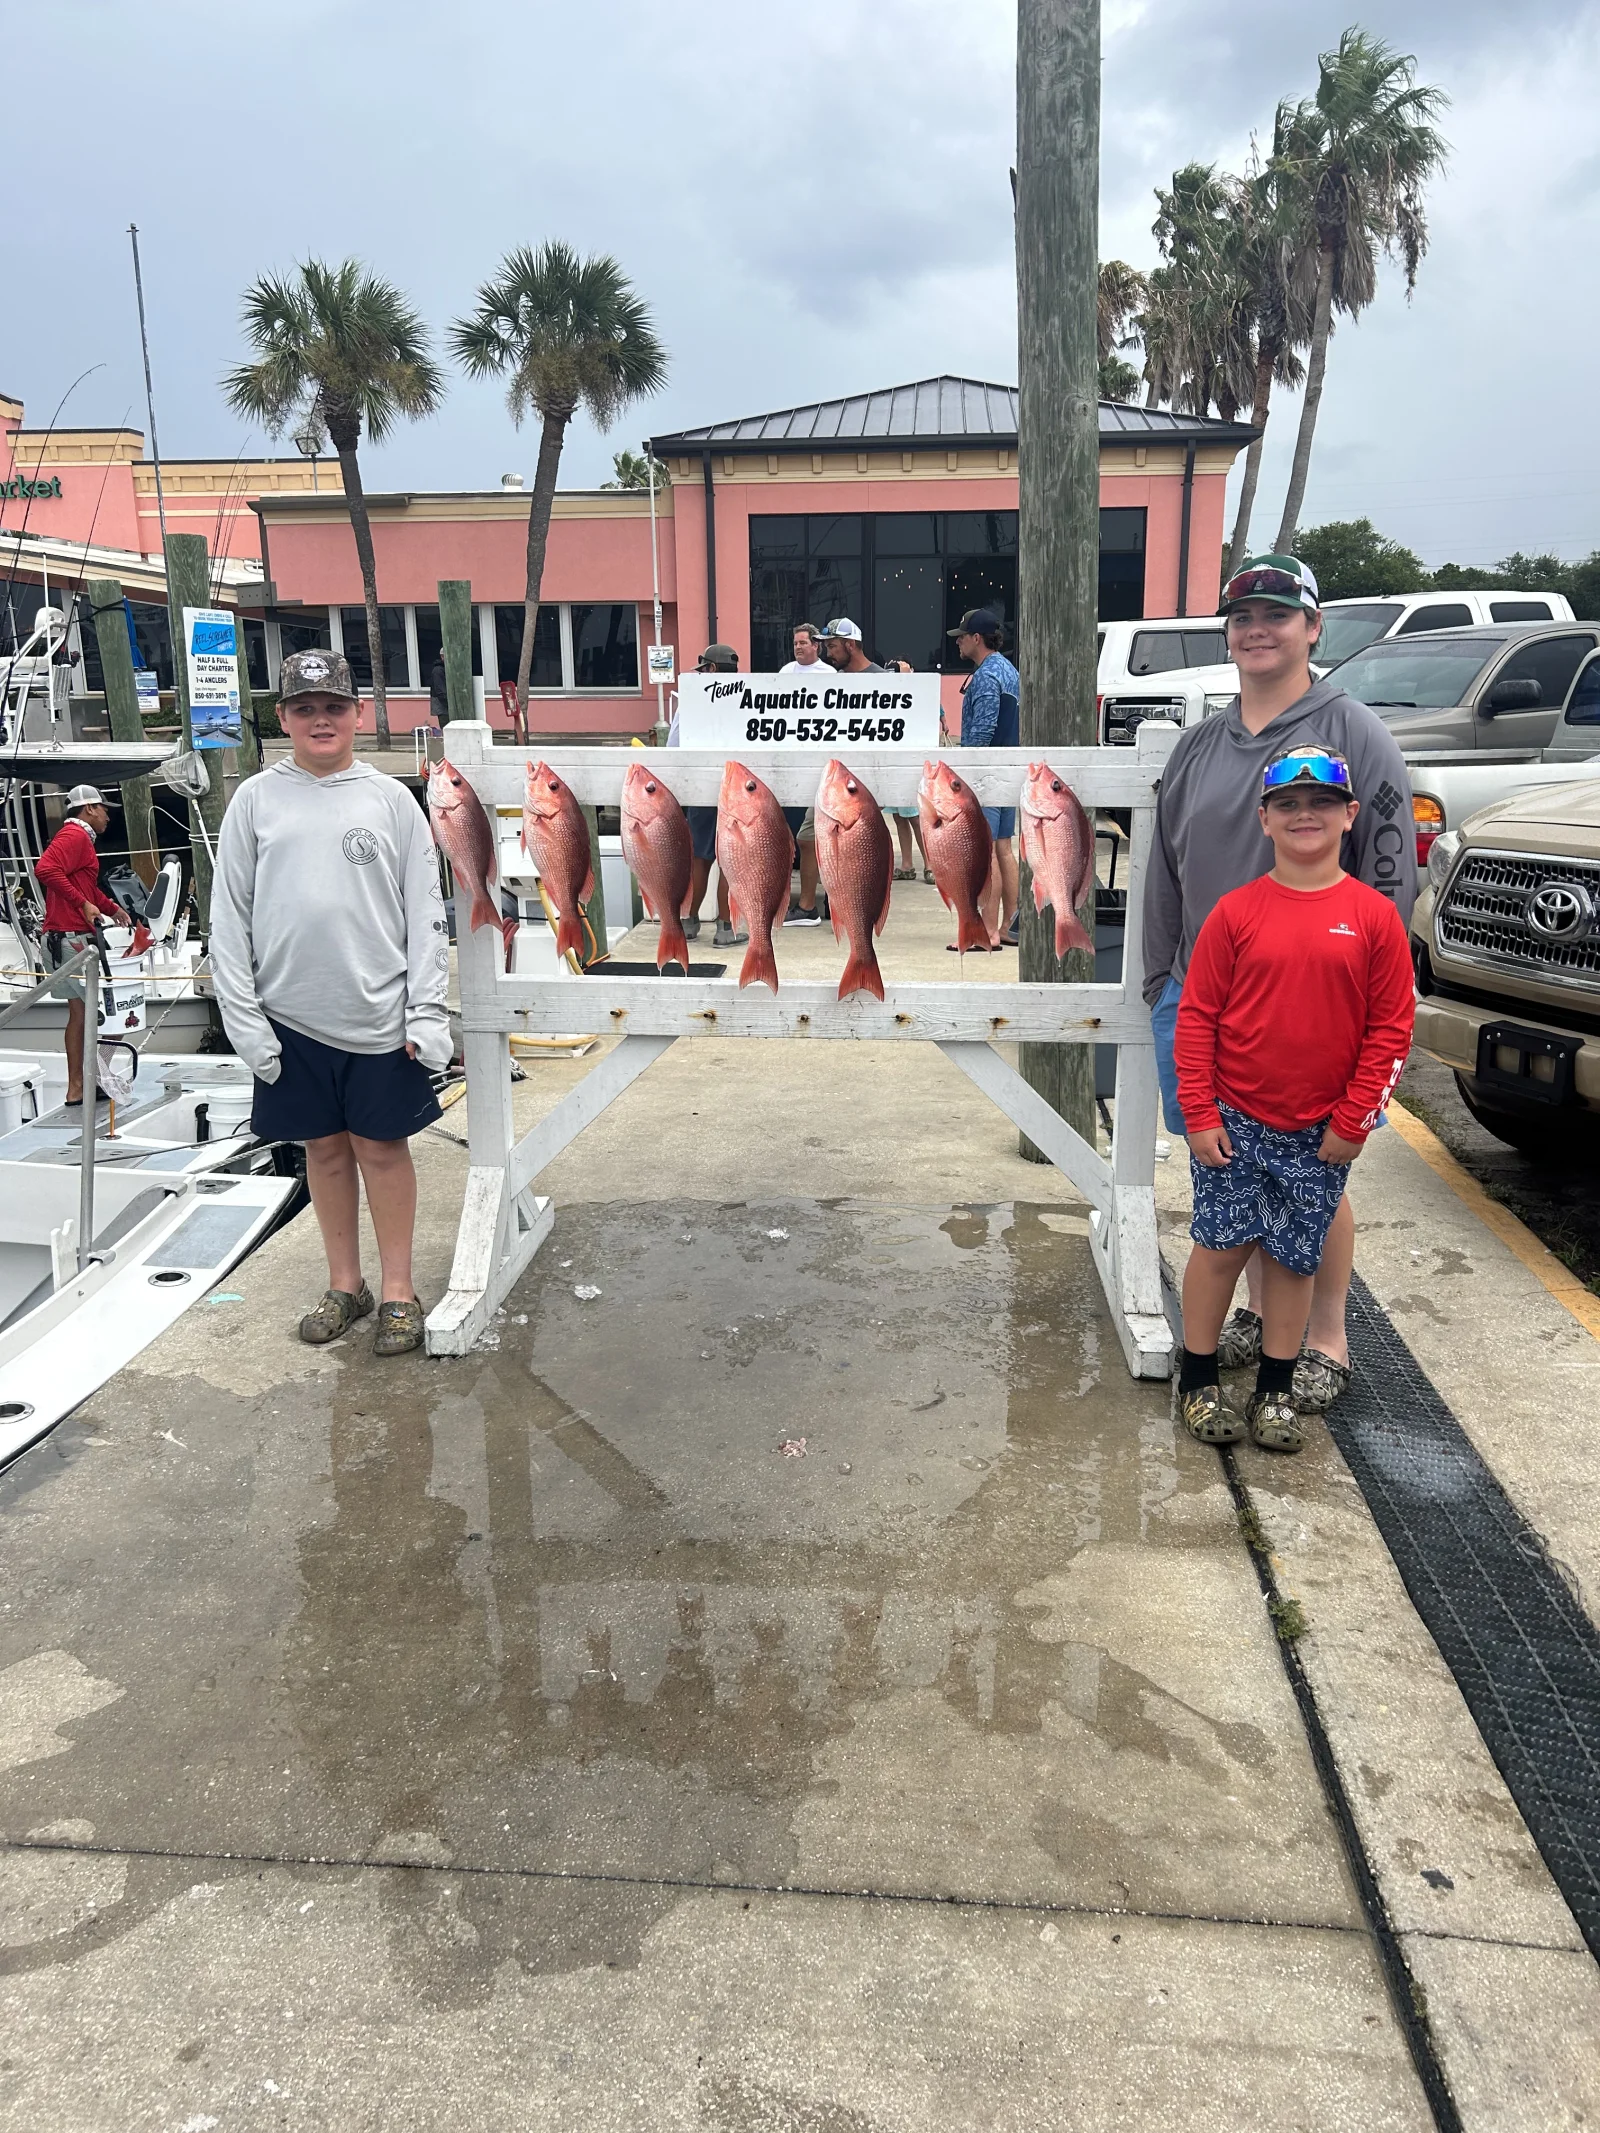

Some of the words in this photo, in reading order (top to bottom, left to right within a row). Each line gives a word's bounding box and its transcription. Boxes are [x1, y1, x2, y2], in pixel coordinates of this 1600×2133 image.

[704, 680, 745, 703] Team
[740, 688, 818, 714] Aquatic
[824, 688, 913, 709] Charters
[746, 718, 905, 742] 850-532-5458
